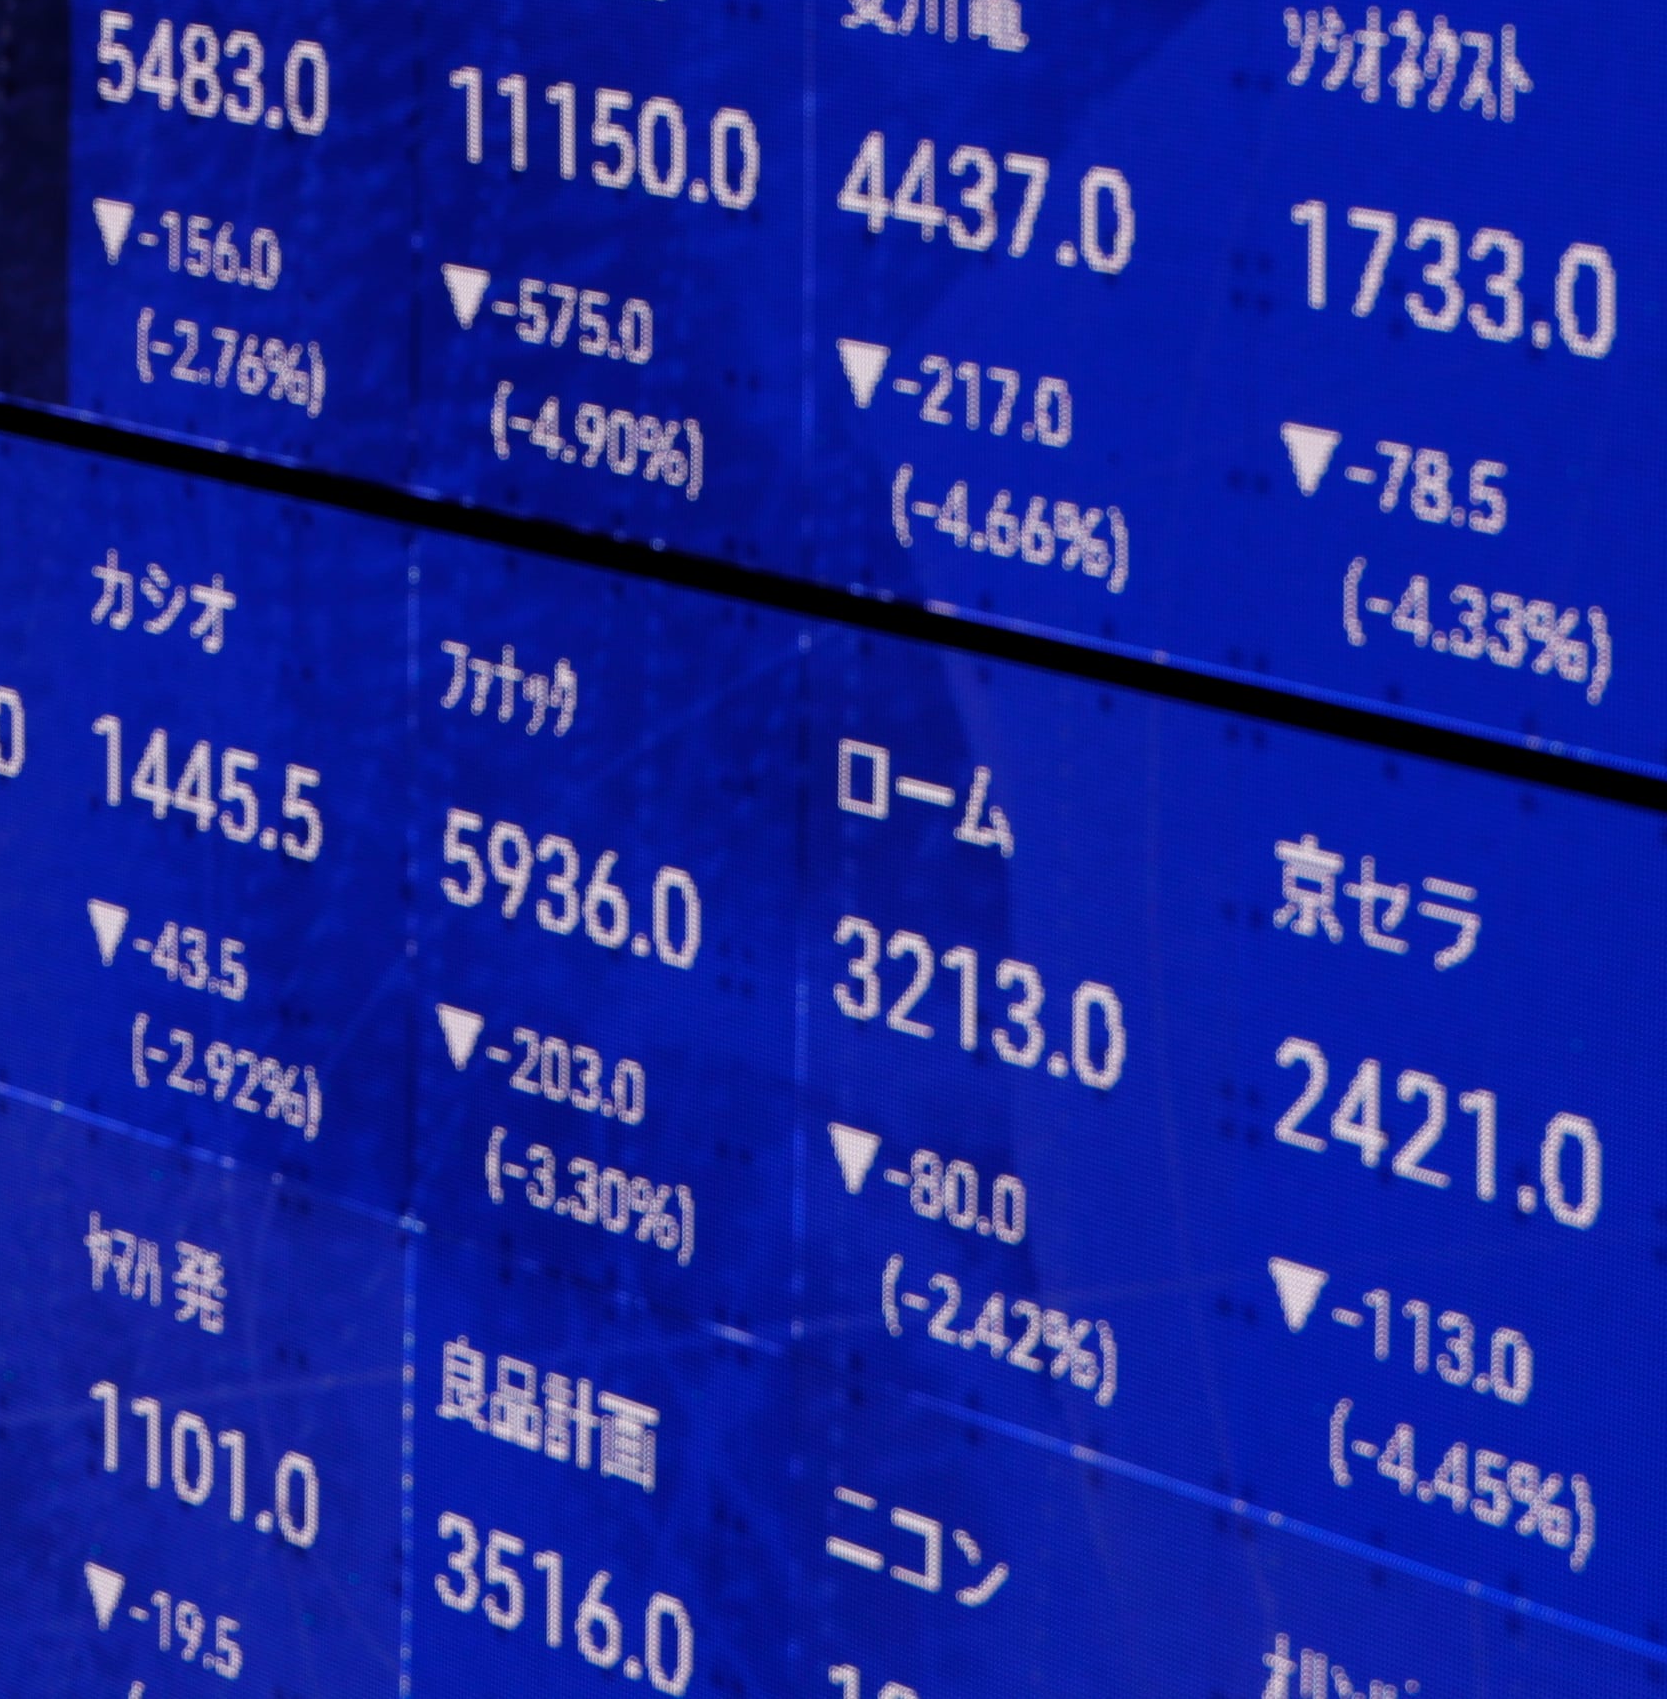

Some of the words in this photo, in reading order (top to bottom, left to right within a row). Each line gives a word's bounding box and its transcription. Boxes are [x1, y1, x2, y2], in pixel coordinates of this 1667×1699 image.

[98, 10, 328, 135] 5483.0
[450, 67, 759, 209] 11150.0
[141, 211, 281, 289] -156.0
[838, 132, 1134, 273] 4437.0
[495, 279, 652, 363] -575.0
[1291, 200, 1615, 358] 1733.0
[491, 381, 702, 496] (-4.90%)
[896, 356, 1071, 447] -217.0
[893, 467, 1128, 592] (-4.66%)
[1347, 441, 1506, 533] -78.5
[92, 553, 235, 653] カシオ
[1344, 561, 1611, 701] (-4.33%)
[94, 715, 322, 861] 1445.5
[838, 739, 1013, 854] ローム
[441, 809, 700, 968] 5936.0
[1274, 835, 1480, 967] 京セラ
[136, 927, 247, 1000] -43.5
[834, 916, 1125, 1089] 3213.0
[489, 1028, 644, 1124] -203.0
[1275, 1037, 1601, 1228] 2421.0
[486, 1127, 693, 1263] (-3.30%)
[884, 1149, 1025, 1243] -80.0
[882, 1254, 1116, 1405] (-2.42%)
[1332, 1290, 1532, 1403] -113.0
[91, 1381, 318, 1547] 1101.0
[439, 1339, 659, 1488] 良品計画
[826, 1487, 1008, 1605] ニコン
[1330, 1399, 1594, 1567] (-4.45%)
[130, 1591, 242, 1678] -19.5
[435, 1512, 693, 1695] 3516.0
